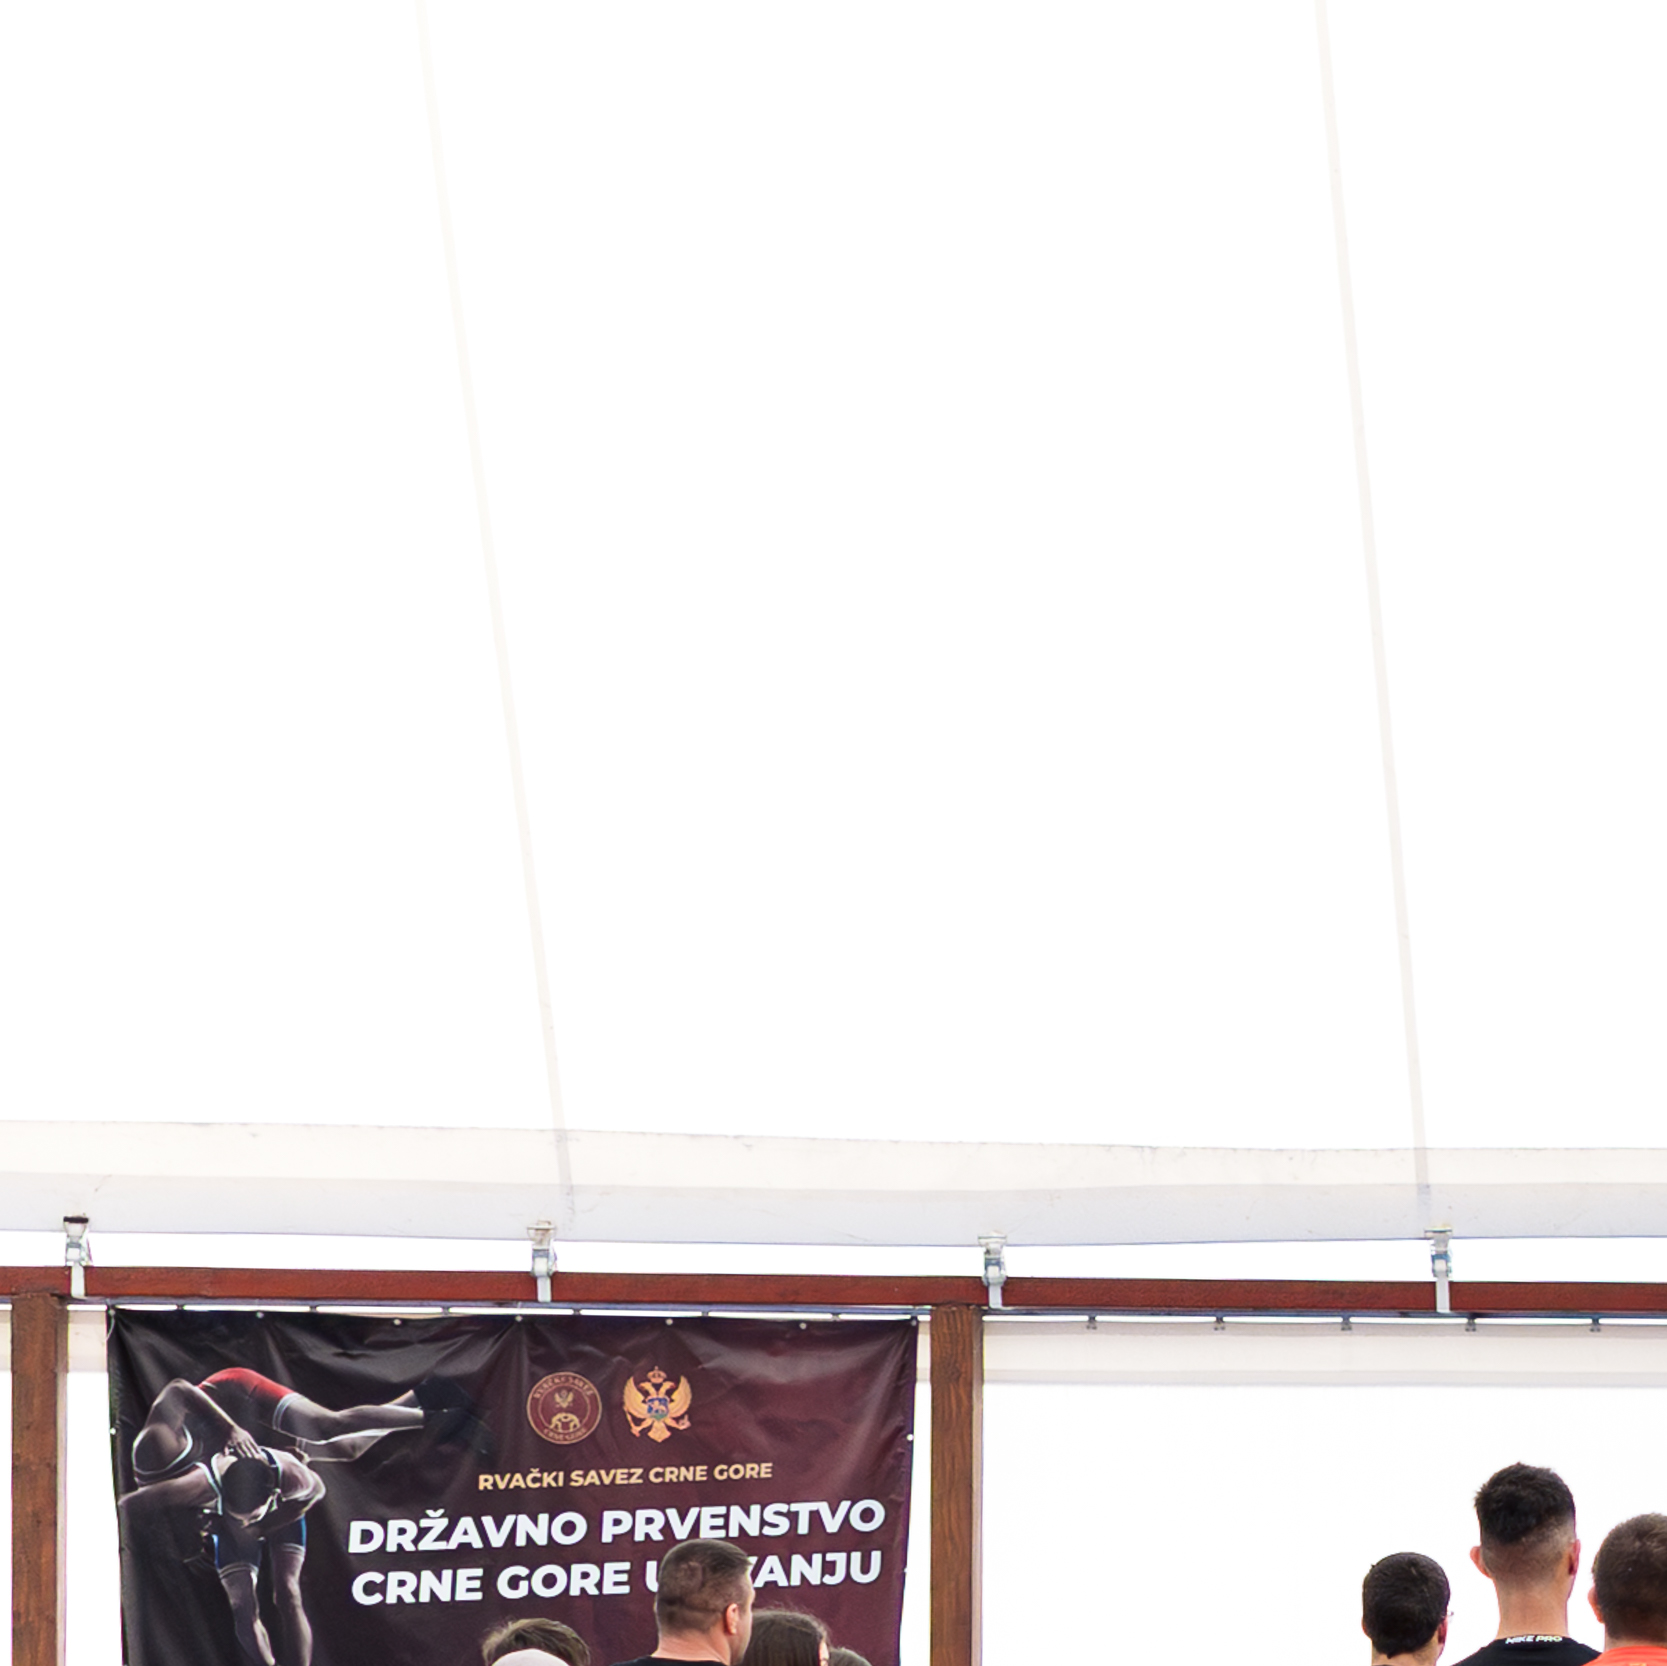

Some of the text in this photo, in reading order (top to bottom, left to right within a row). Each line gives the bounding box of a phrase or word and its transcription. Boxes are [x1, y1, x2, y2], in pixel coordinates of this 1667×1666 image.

[478, 1462, 773, 1491] RVAČKI SAVEZ CRNE GORE
[347, 1499, 886, 1554] DRŽAVNO PRVENSTVO
[351, 1569, 483, 1605] CRNE
[496, 1561, 631, 1600] GORE
[750, 1550, 882, 1588] ANJU
[1535, 1635, 1563, 1643] PRO
